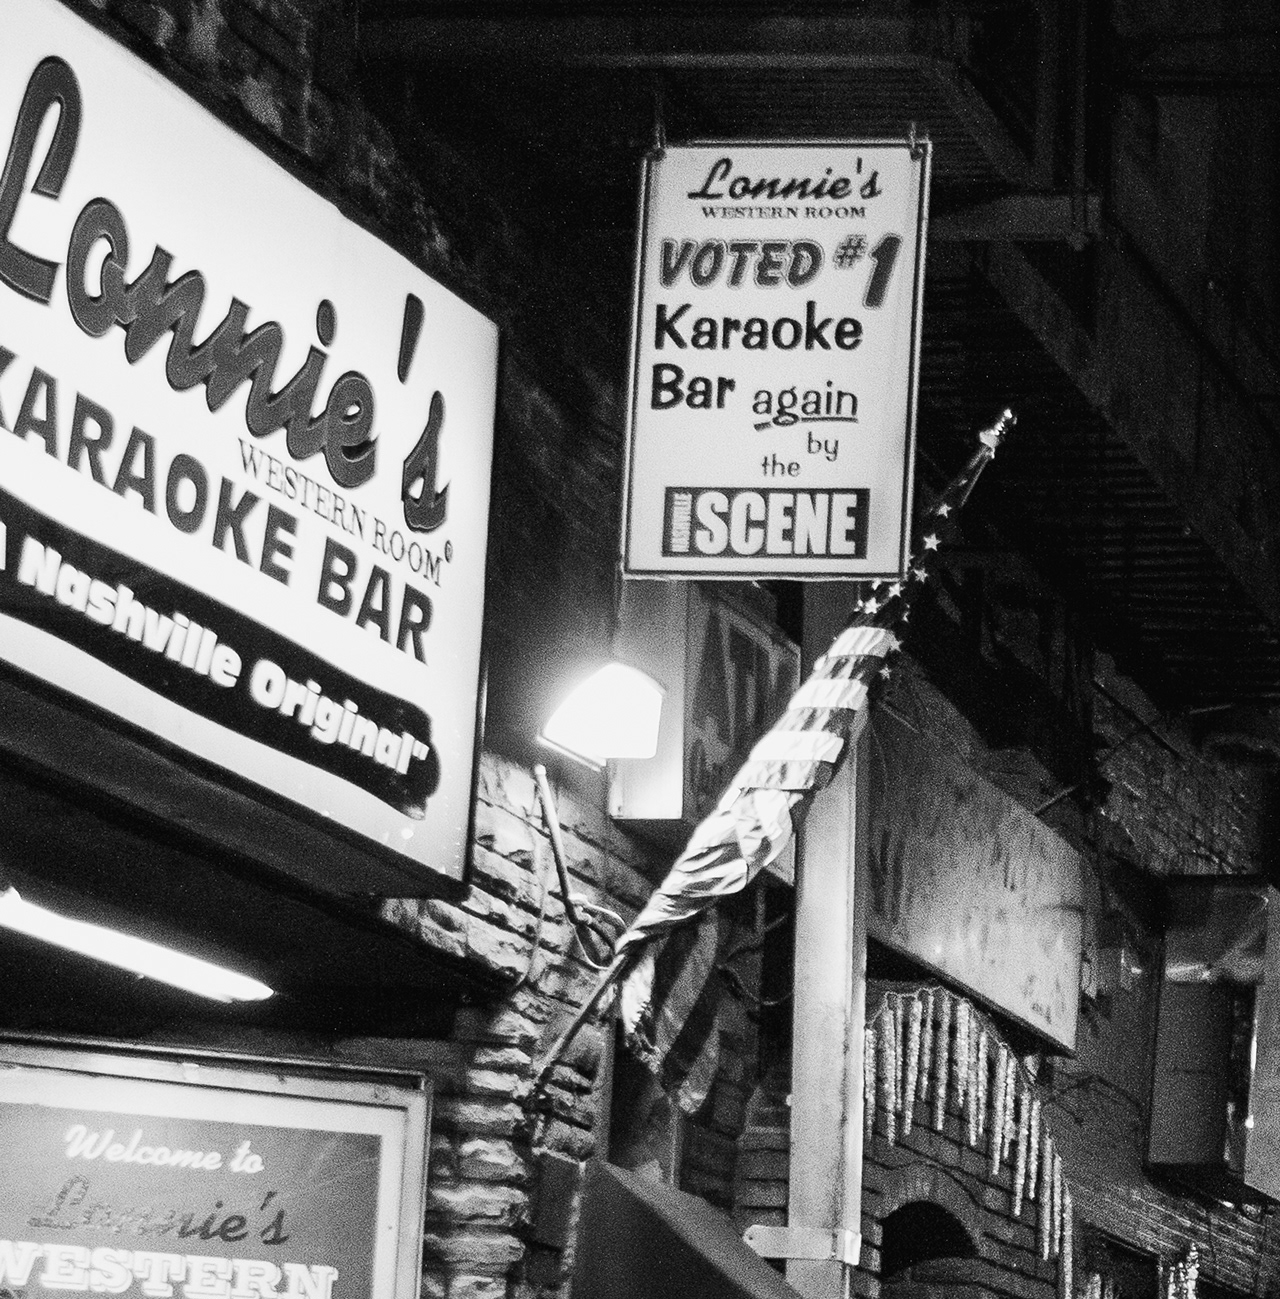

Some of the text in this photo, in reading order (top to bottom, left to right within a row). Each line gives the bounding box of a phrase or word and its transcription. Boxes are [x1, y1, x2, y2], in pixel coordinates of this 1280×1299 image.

[687, 157, 883, 201] Lonnie's
[701, 206, 867, 219] WESTERN ROOM
[0, 55, 451, 532] Lonnie's
[659, 232, 903, 310] VOTED #1
[654, 300, 864, 351] Karaoke
[650, 363, 859, 427] Bar again
[762, 454, 800, 477] the
[807, 431, 839, 462] by
[238, 436, 367, 546] WESTERN
[695, 491, 858, 556] SCENE
[17, 533, 242, 689] Nashville
[316, 535, 435, 667] BAR
[64, 1124, 265, 1174] Welcome to
